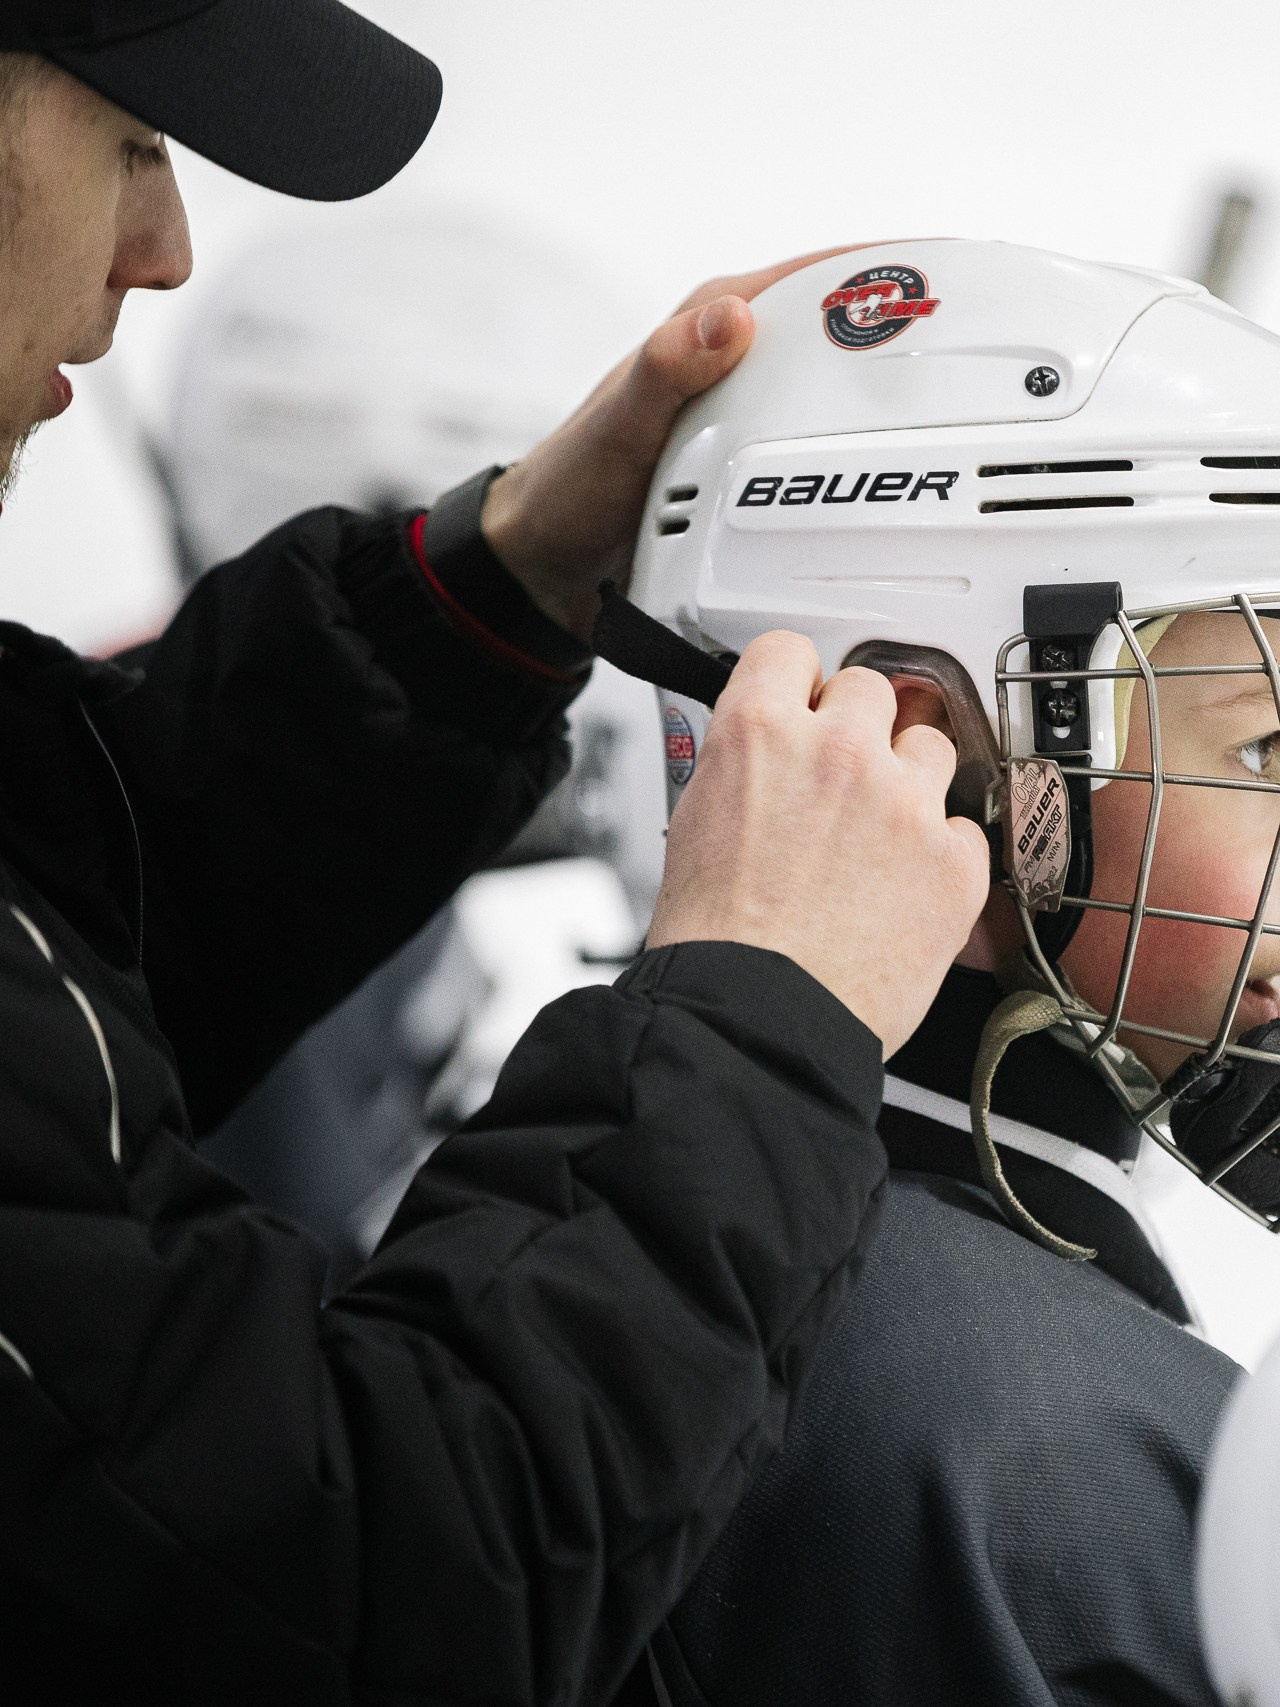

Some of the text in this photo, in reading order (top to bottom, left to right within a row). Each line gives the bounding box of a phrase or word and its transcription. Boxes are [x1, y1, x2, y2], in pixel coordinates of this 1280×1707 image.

[869, 270, 914, 284] ЦЕНТР
[821, 282, 899, 309] OVER
[736, 471, 959, 507] BAUER
[1012, 768, 1041, 804] OVAL
[1017, 777, 1060, 855] BAUER
